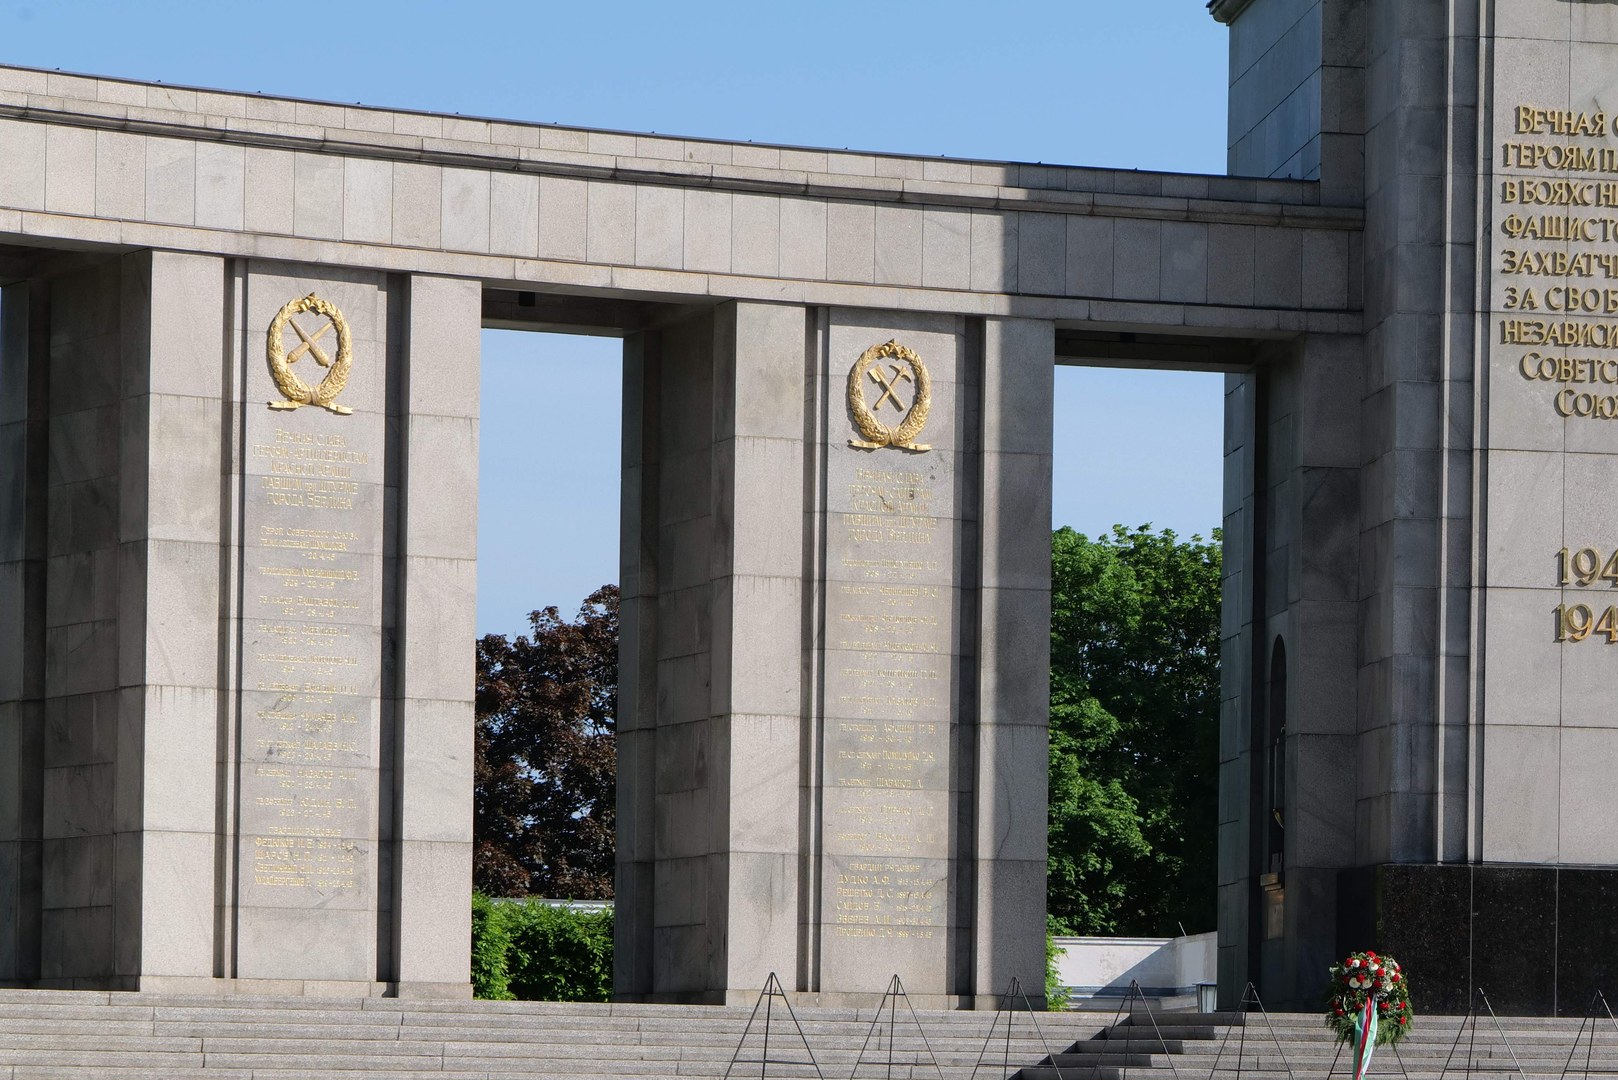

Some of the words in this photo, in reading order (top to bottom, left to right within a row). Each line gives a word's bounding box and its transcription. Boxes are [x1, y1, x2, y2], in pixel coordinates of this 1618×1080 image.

[1516, 104, 1608, 136] ВЕЧНАЯ
[1505, 141, 1597, 170] ГЕРОЯМ
[1505, 180, 1518, 202] В
[1504, 287, 1539, 310] ЗА
